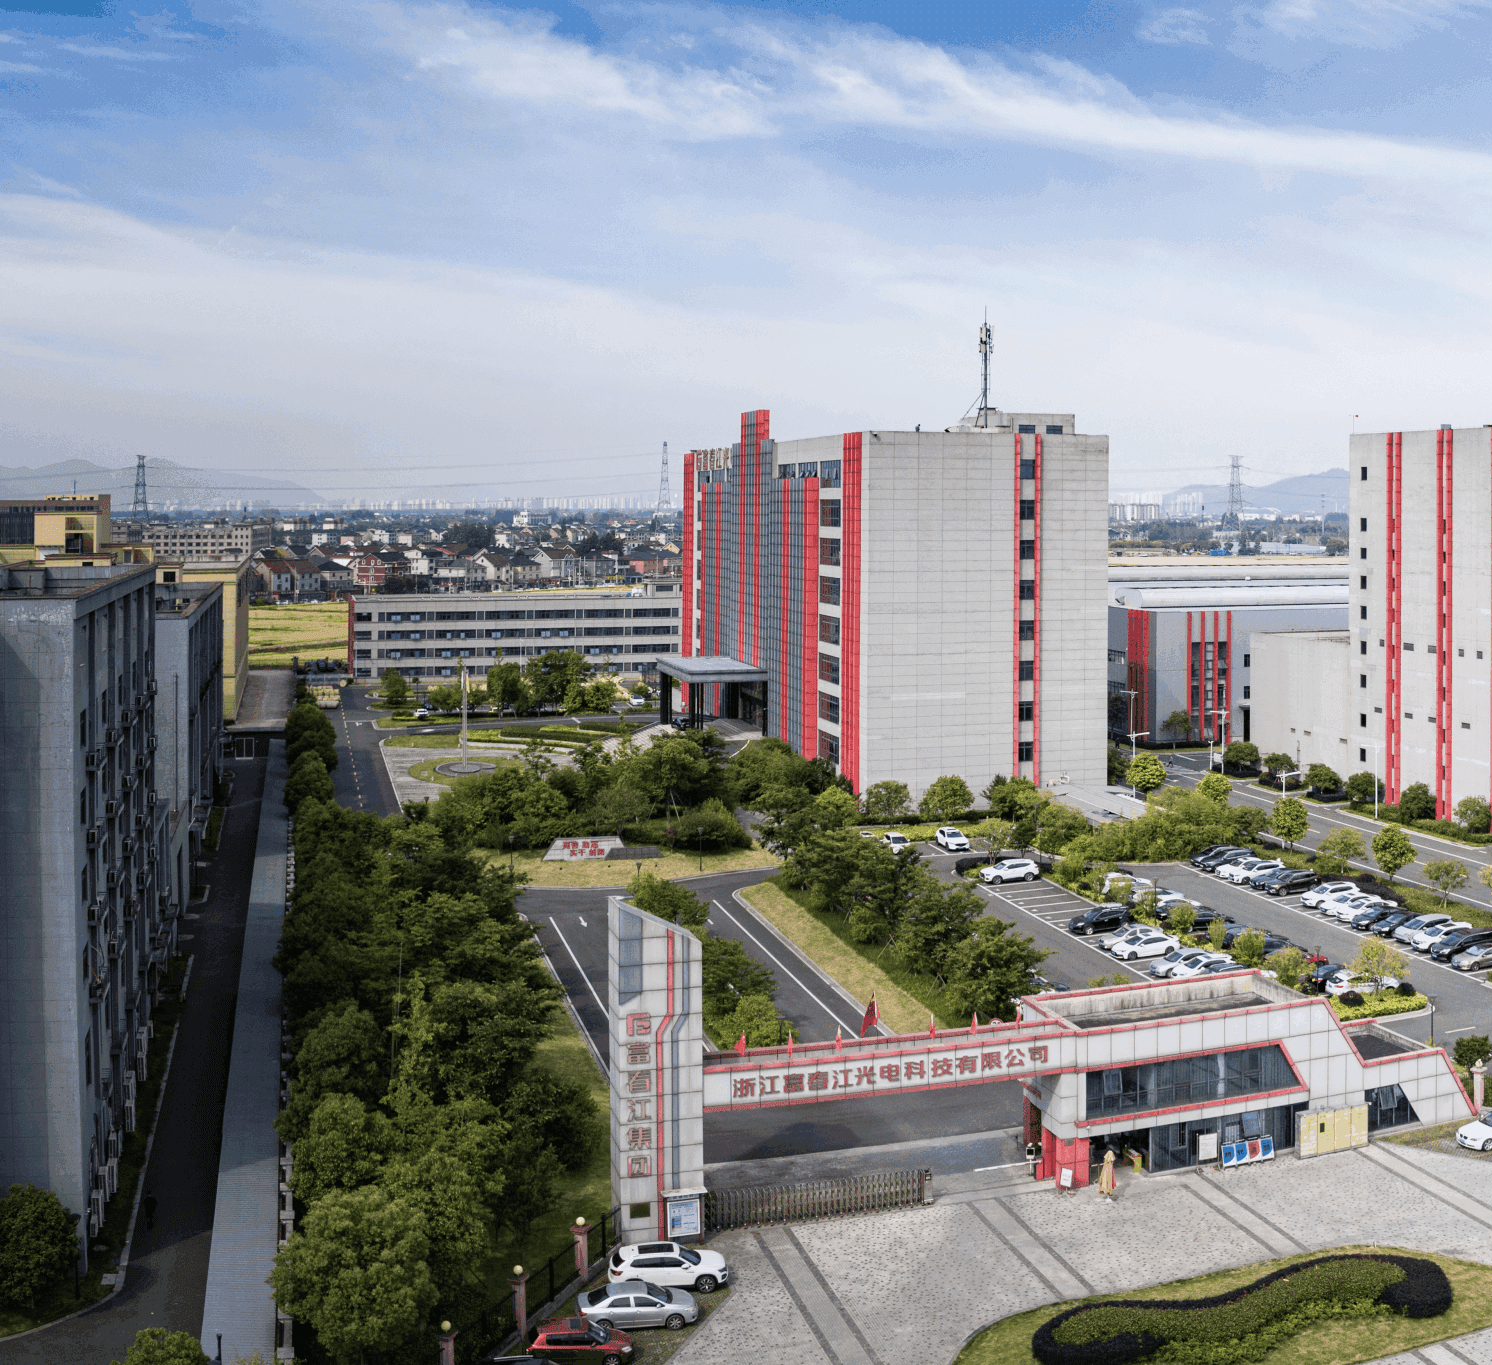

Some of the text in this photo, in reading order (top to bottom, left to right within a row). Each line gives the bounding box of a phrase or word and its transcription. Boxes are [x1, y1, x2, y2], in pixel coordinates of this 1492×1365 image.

[627, 1042, 652, 1178] 富春江集团
[732, 1045, 1049, 1098] 浙江富春江光电科技有限公司
